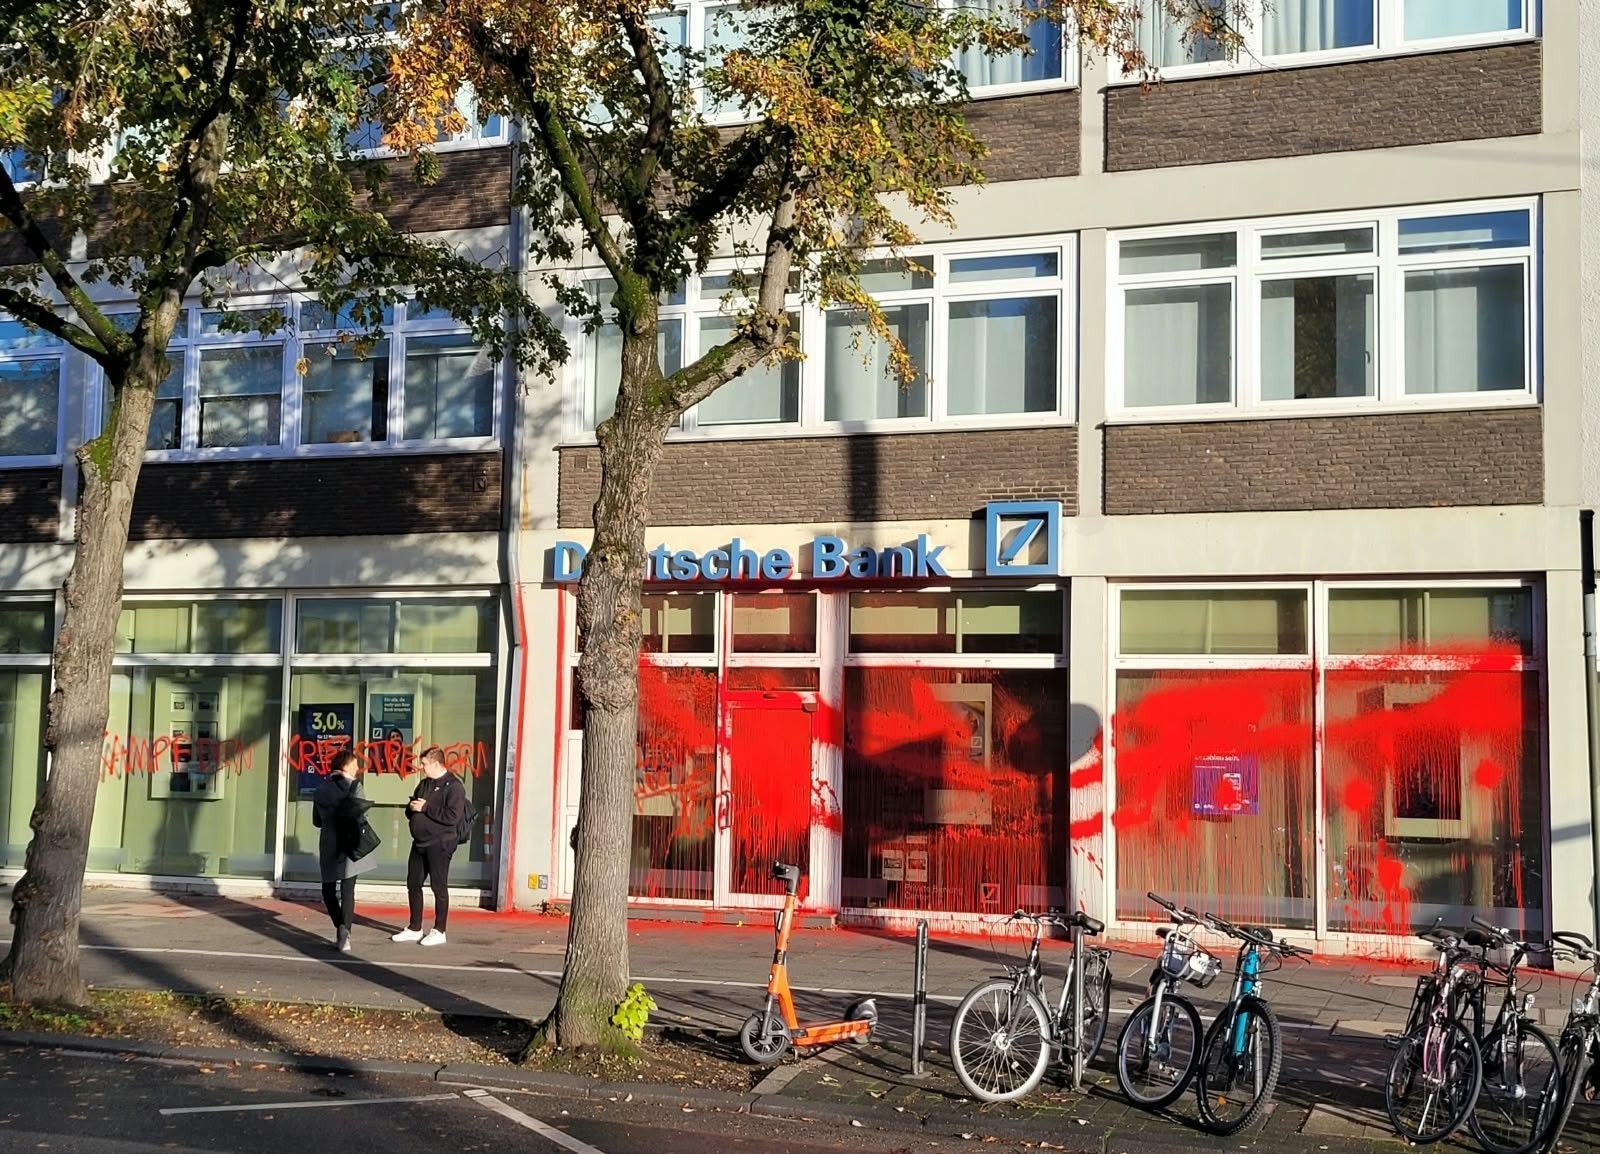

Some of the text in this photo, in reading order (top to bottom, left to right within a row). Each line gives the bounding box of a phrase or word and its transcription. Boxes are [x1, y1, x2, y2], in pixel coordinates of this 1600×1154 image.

[554, 533, 950, 581] Dtsche Bank
[312, 712, 345, 733] 3,0%
